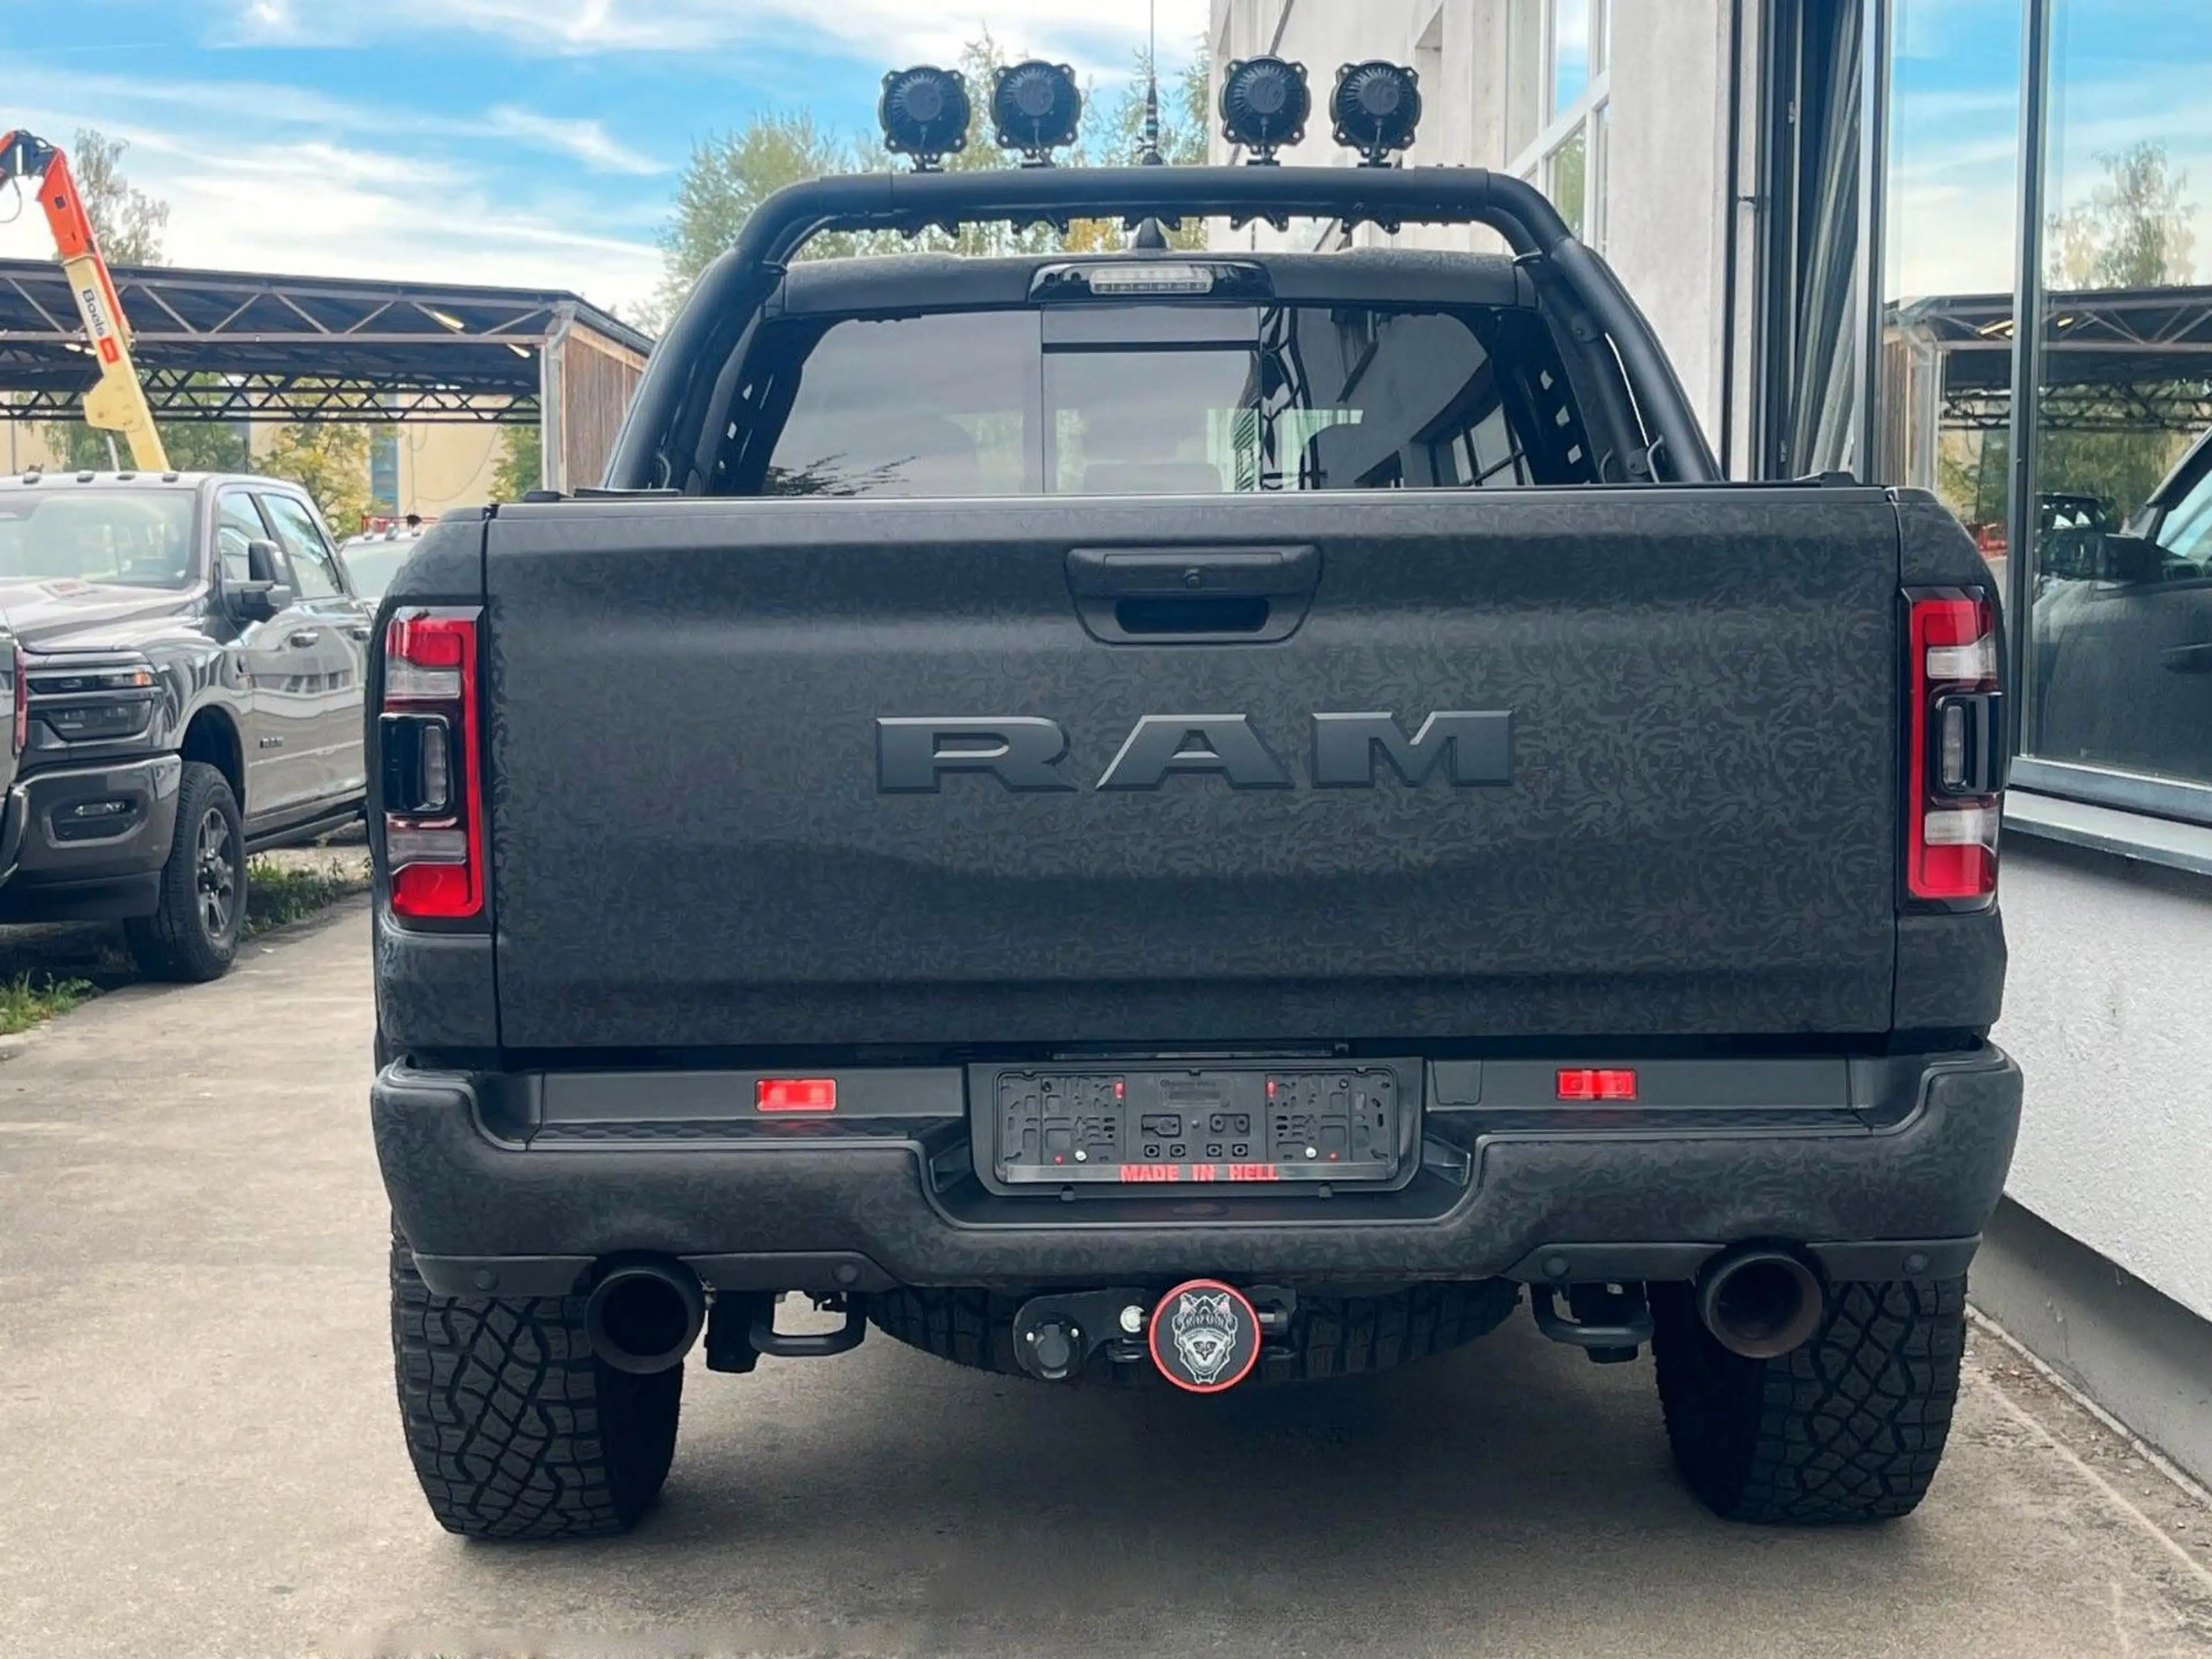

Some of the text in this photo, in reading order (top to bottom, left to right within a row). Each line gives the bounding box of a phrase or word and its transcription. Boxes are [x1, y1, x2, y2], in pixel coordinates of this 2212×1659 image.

[876, 711, 1514, 793] RAM
[1120, 1163, 1279, 1181] MADE IN HELL
